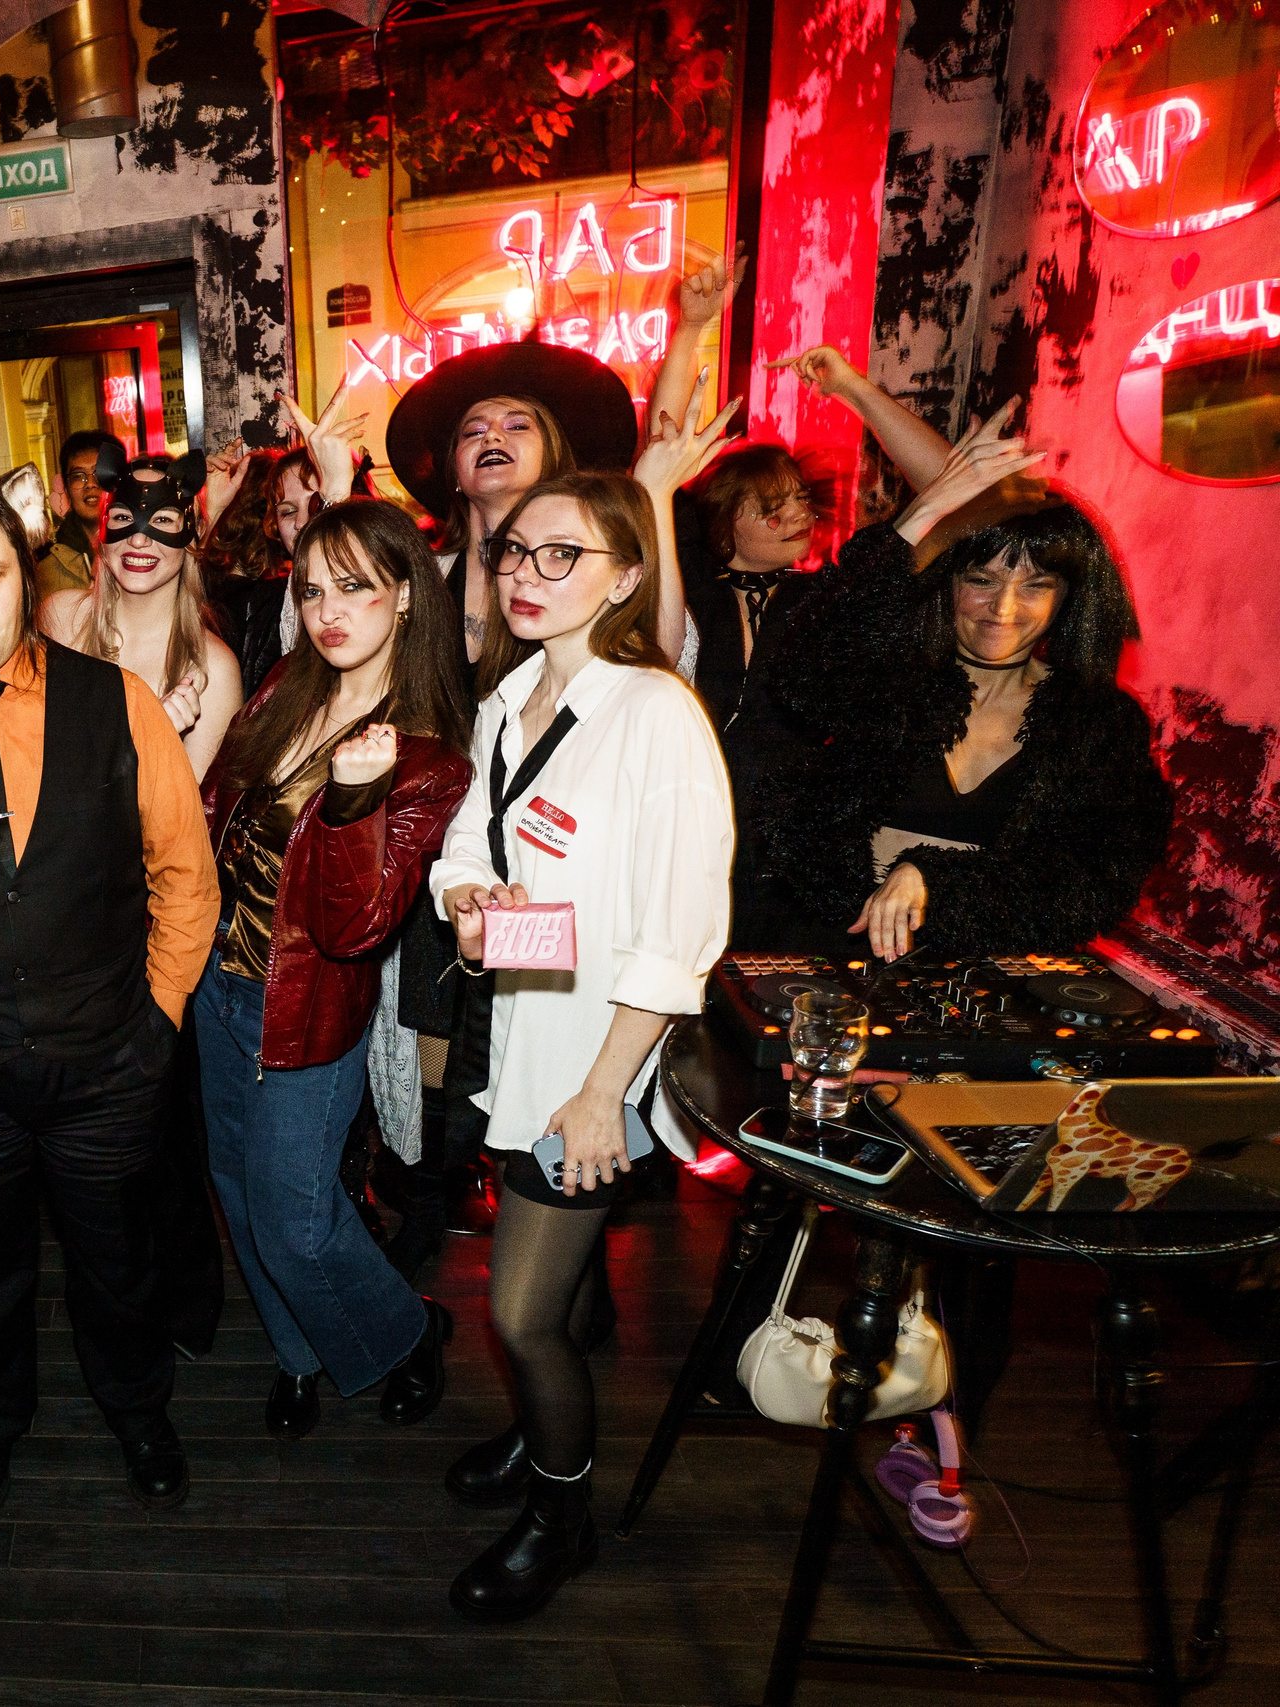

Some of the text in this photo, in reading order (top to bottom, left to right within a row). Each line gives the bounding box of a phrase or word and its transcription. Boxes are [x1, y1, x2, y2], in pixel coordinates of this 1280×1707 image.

[541, 803, 565, 822] HELLO
[520, 817, 545, 835] BROKEN
[544, 832, 569, 848] HEART
[498, 912, 568, 938] FIGHT
[485, 929, 563, 961] CLUB
